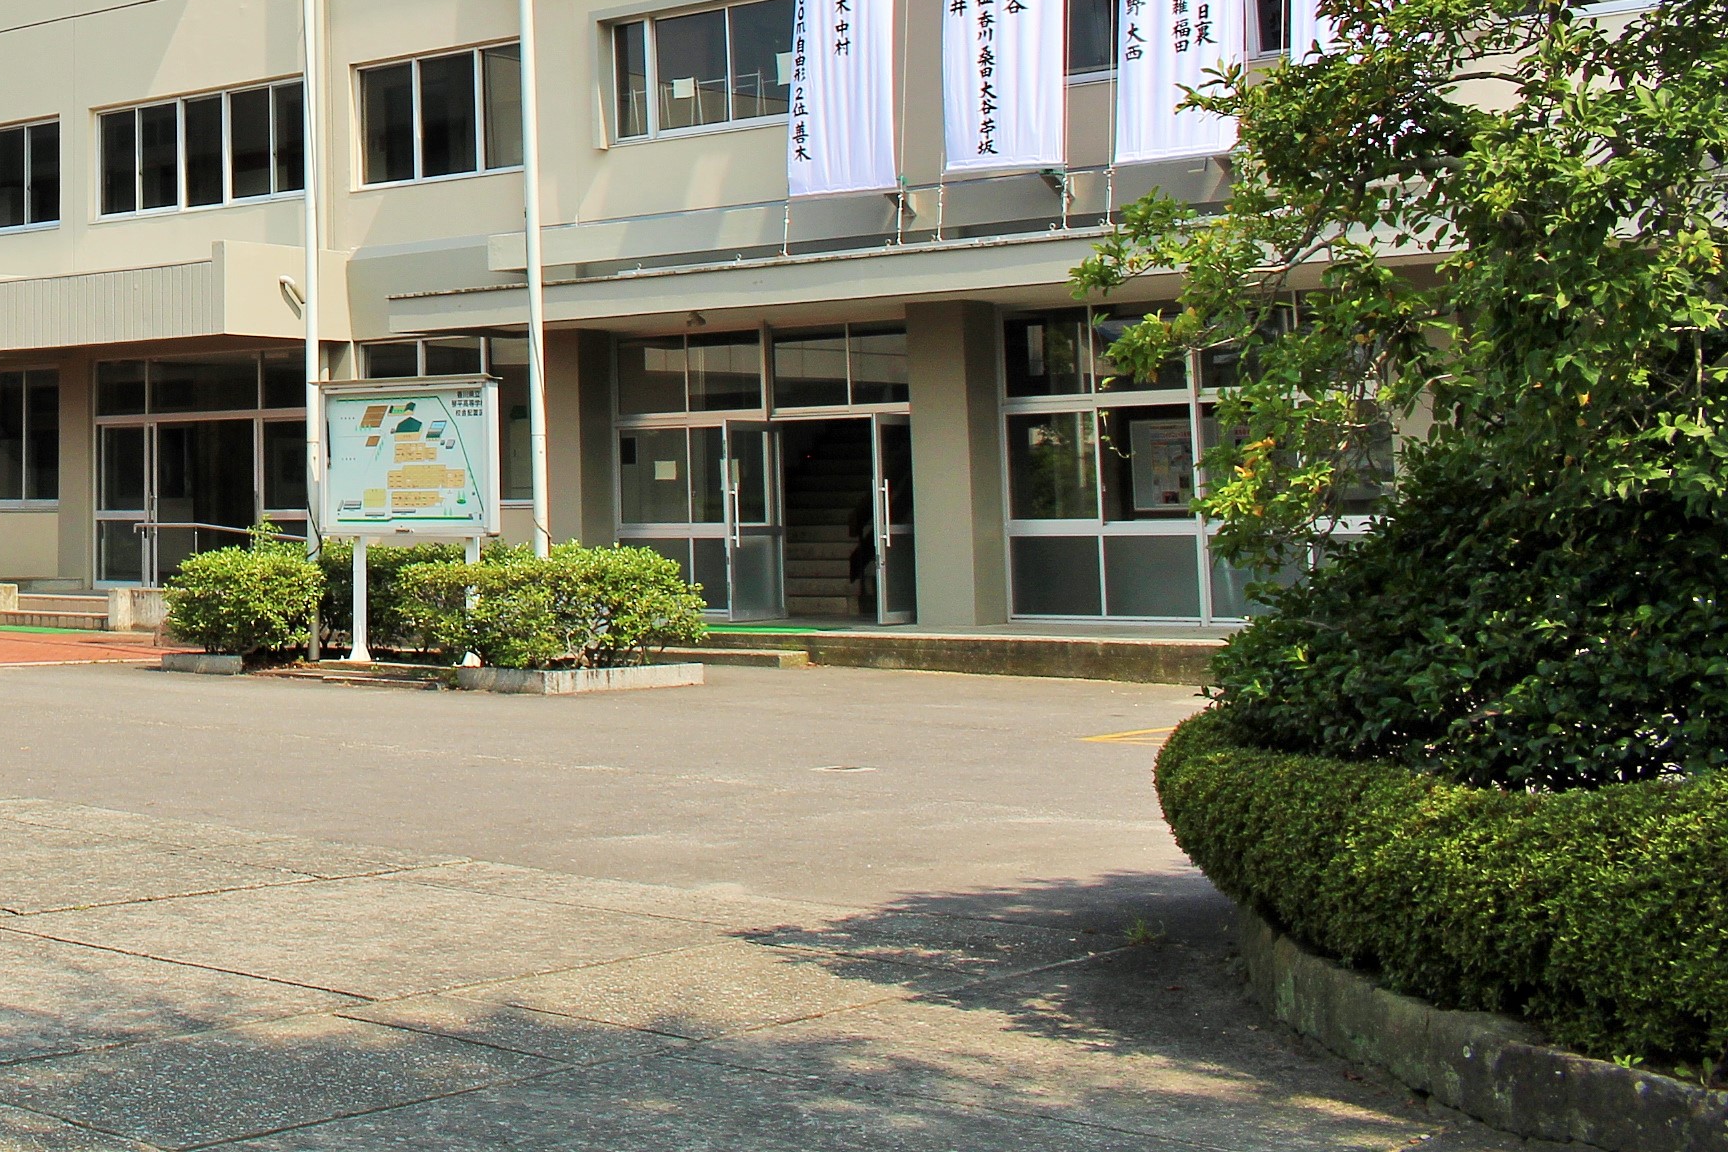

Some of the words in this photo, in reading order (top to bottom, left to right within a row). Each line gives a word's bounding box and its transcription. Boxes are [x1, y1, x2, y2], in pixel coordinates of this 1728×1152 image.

[834, 20, 851, 56] 中村
[978, 10, 996, 41] 香川
[1125, 23, 1146, 61] 大西
[1172, 18, 1191, 53] 福田
[977, 45, 996, 78] 桑田
[792, 87, 808, 117] 2位
[979, 81, 998, 115] 大谷
[792, 121, 812, 162] 善木
